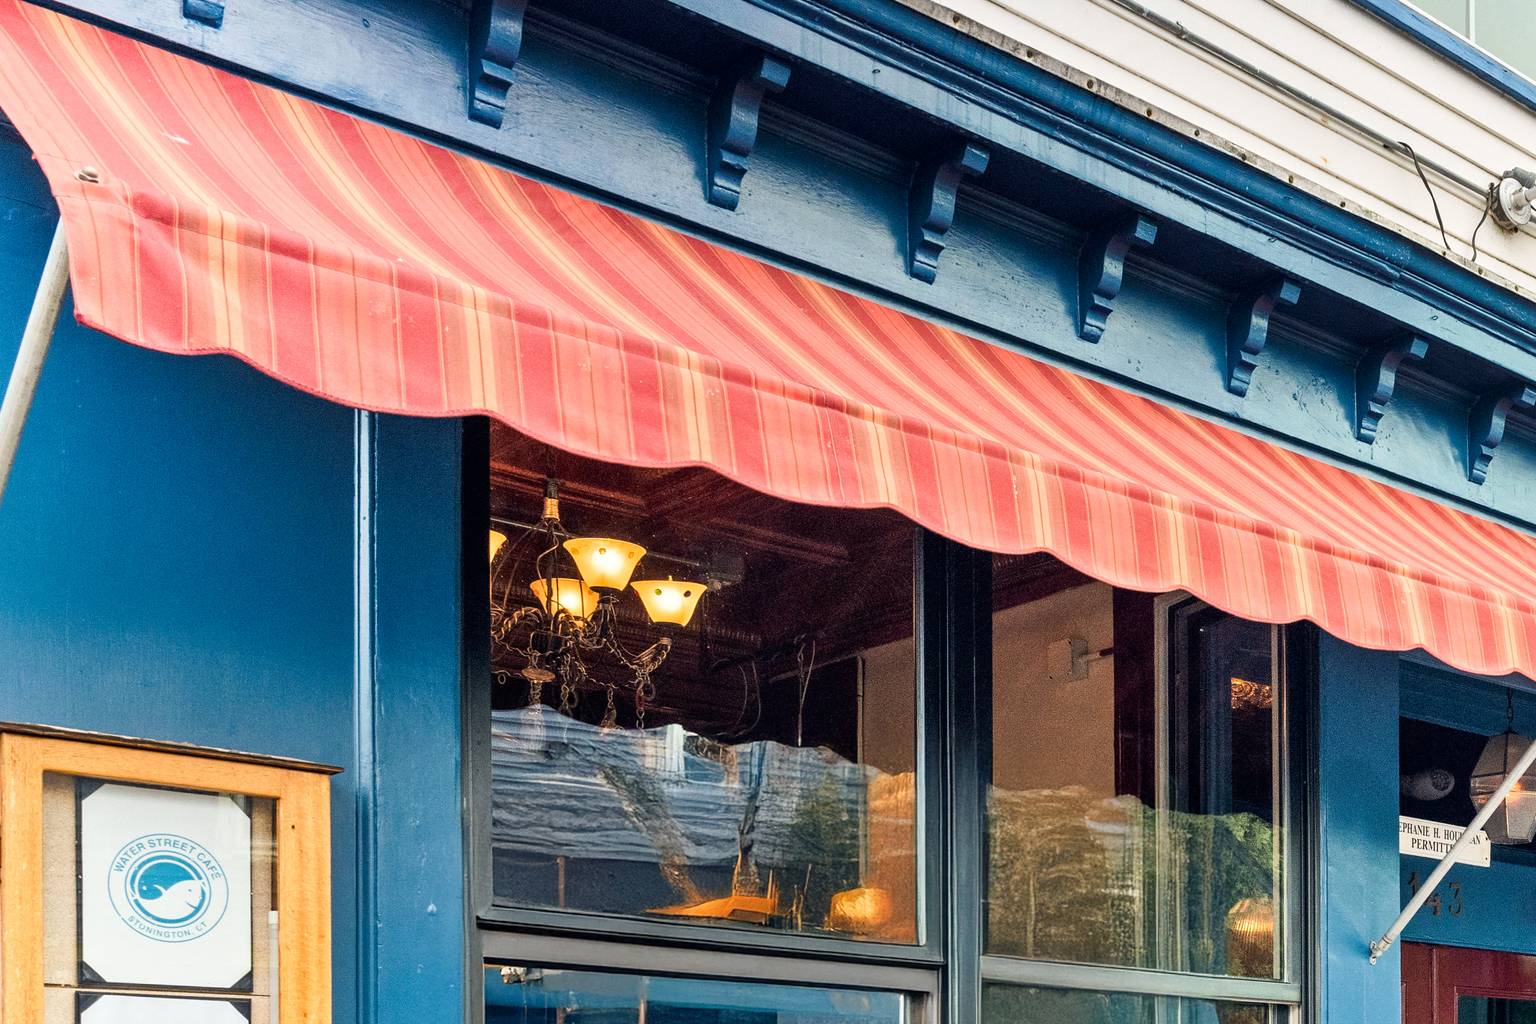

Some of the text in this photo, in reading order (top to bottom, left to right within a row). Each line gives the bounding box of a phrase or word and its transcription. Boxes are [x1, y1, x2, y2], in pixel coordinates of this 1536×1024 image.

[1433, 827, 1441, 838] H.
[113, 842, 146, 873] WATER
[147, 838, 198, 854] STREET
[195, 920, 208, 932] CT
